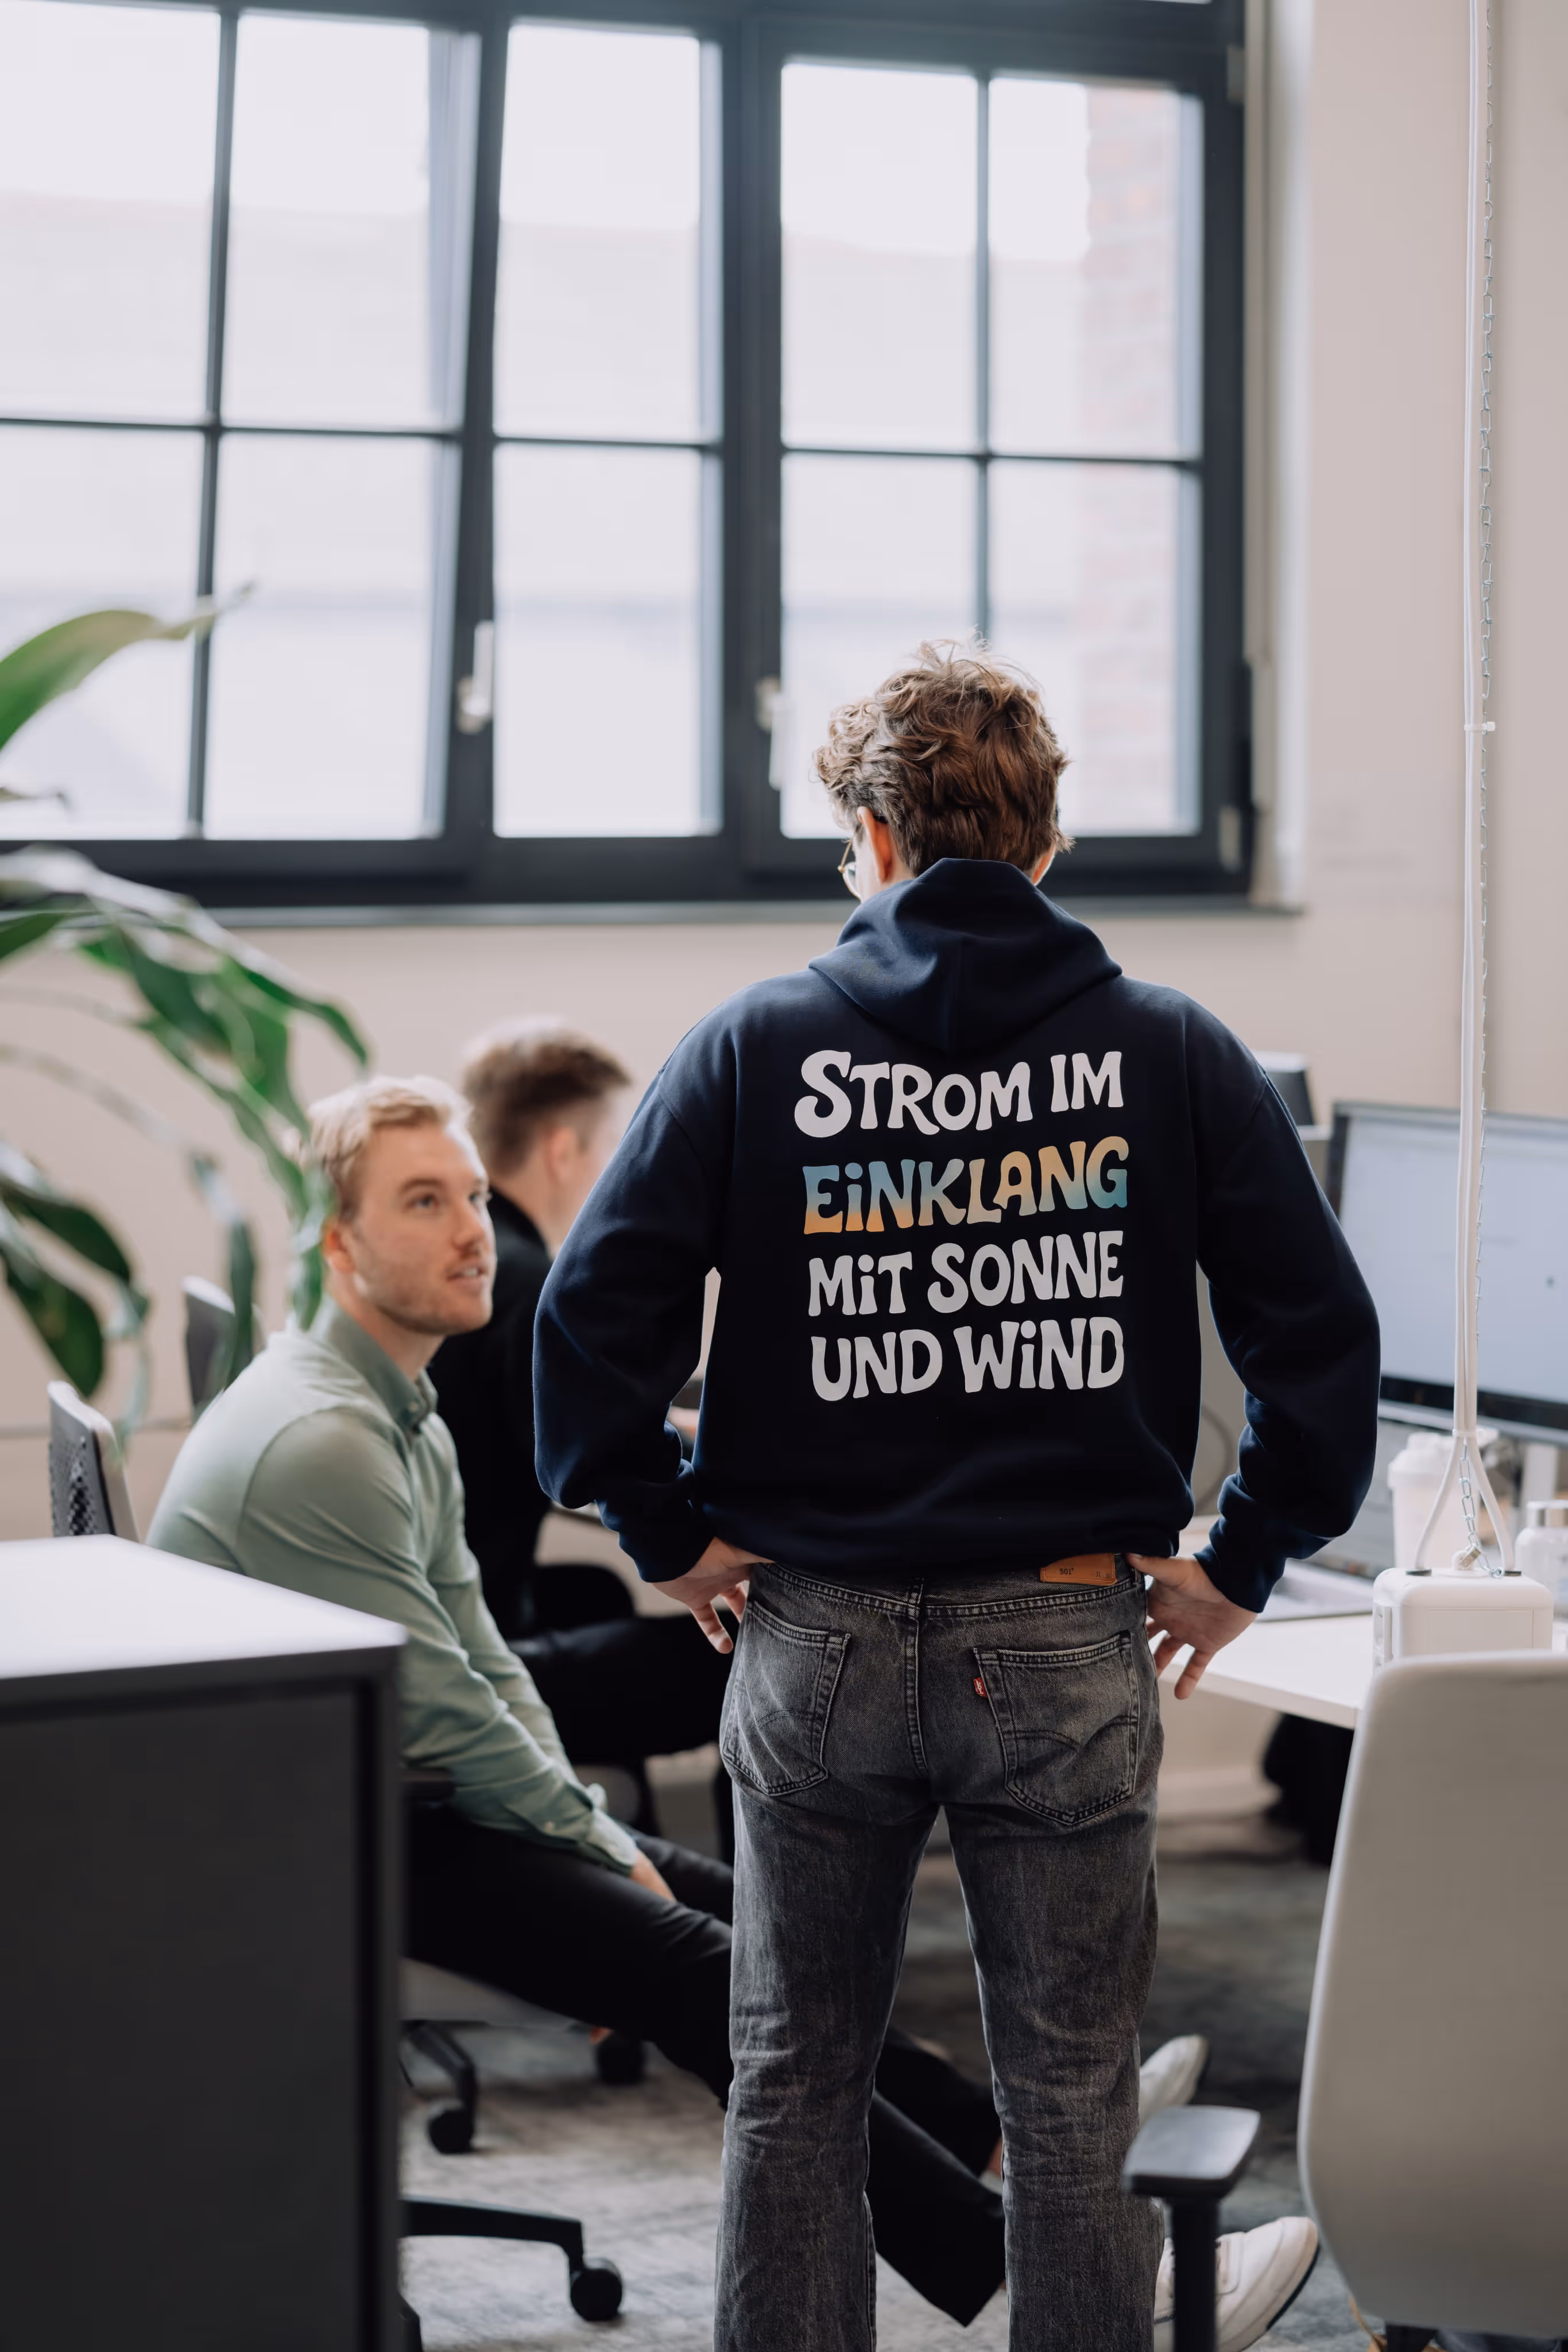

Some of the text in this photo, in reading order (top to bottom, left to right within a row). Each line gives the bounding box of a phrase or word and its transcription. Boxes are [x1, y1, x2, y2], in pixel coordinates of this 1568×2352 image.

[795, 1050, 1123, 1138] STROM IM
[928, 1231, 1123, 1313] SONNE
[811, 1329, 942, 1401] UND
